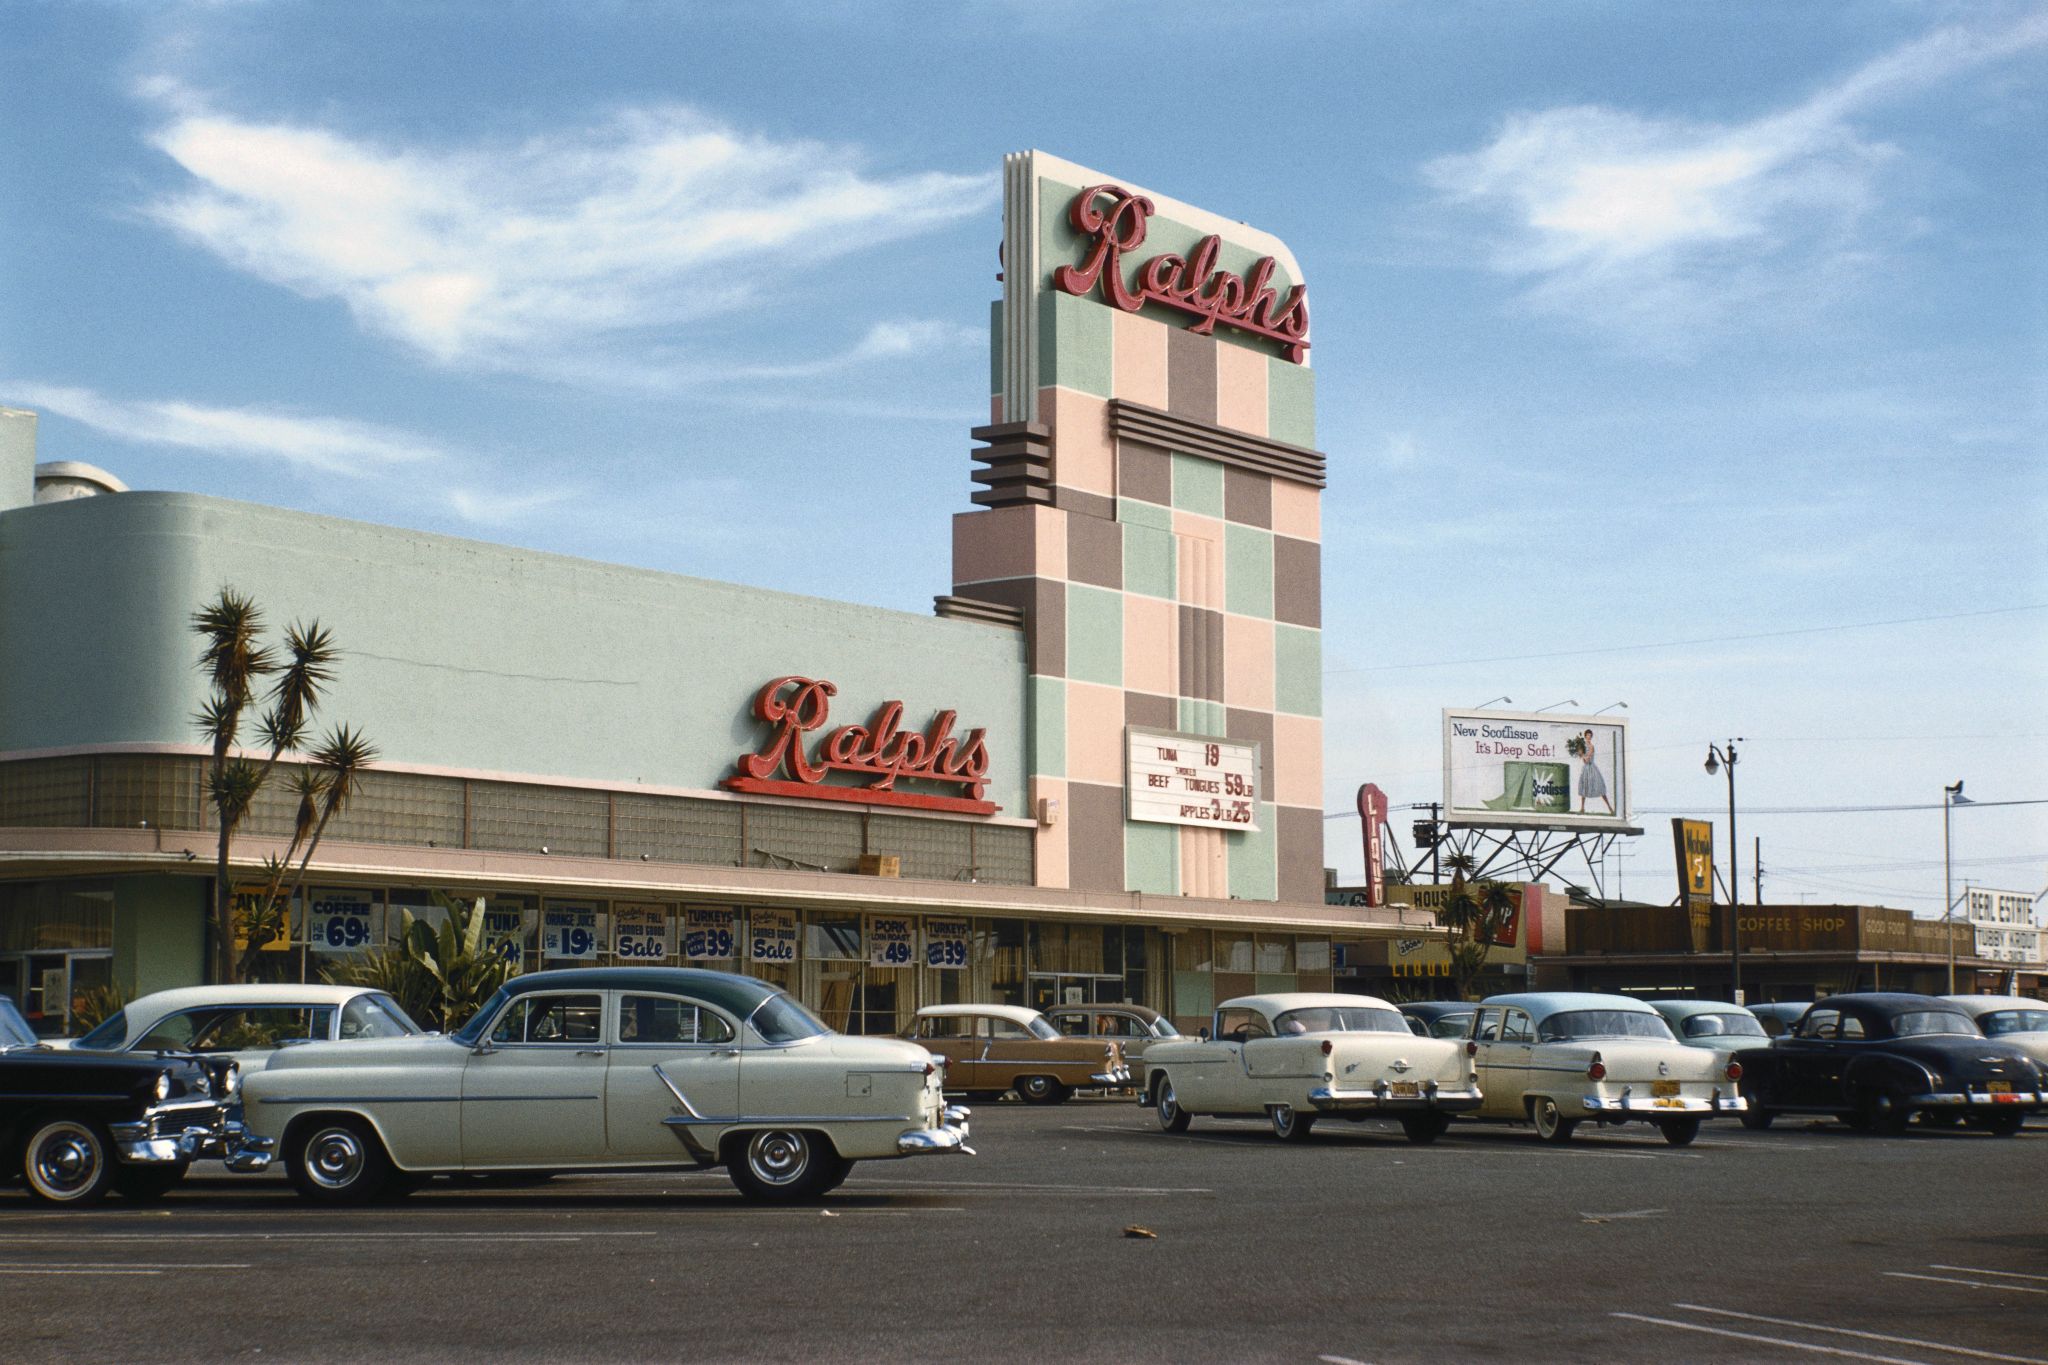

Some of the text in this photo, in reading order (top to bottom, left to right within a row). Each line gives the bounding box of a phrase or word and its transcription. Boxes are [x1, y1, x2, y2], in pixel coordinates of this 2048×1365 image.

[1054, 184, 1310, 362] Ralphs
[737, 676, 991, 800] Ralphs
[1453, 723, 1539, 740] New ScotTissue
[1157, 744, 1220, 766] TUNA 19
[1476, 741, 1491, 754] It's
[1494, 742, 1522, 758] Deep
[1148, 774, 1170, 788] BEEF
[1185, 778, 1220, 794] TONGUES
[1180, 805, 1210, 819] APPLES
[1367, 794, 1383, 905] LIQUO
[1414, 890, 1449, 907] HOUS
[313, 901, 370, 915] COFFEE
[688, 910, 734, 923] TURKEYS
[1972, 892, 2033, 925] REAL ESTATE
[546, 913, 596, 927] ORANGE JUICE
[647, 912, 662, 923] FALL
[778, 916, 793, 928] FALL
[1737, 917, 1845, 932] COFFEE SHOP
[875, 920, 907, 934] PORK
[928, 922, 967, 935] TURKEYS
[1865, 919, 1886, 934] GOOD
[1888, 921, 1906, 936] FOOD
[871, 933, 911, 942] LOIN ROAST
[619, 936, 663, 957] Sale
[753, 938, 793, 959] Sale
[1392, 960, 1449, 977] LIQUO
